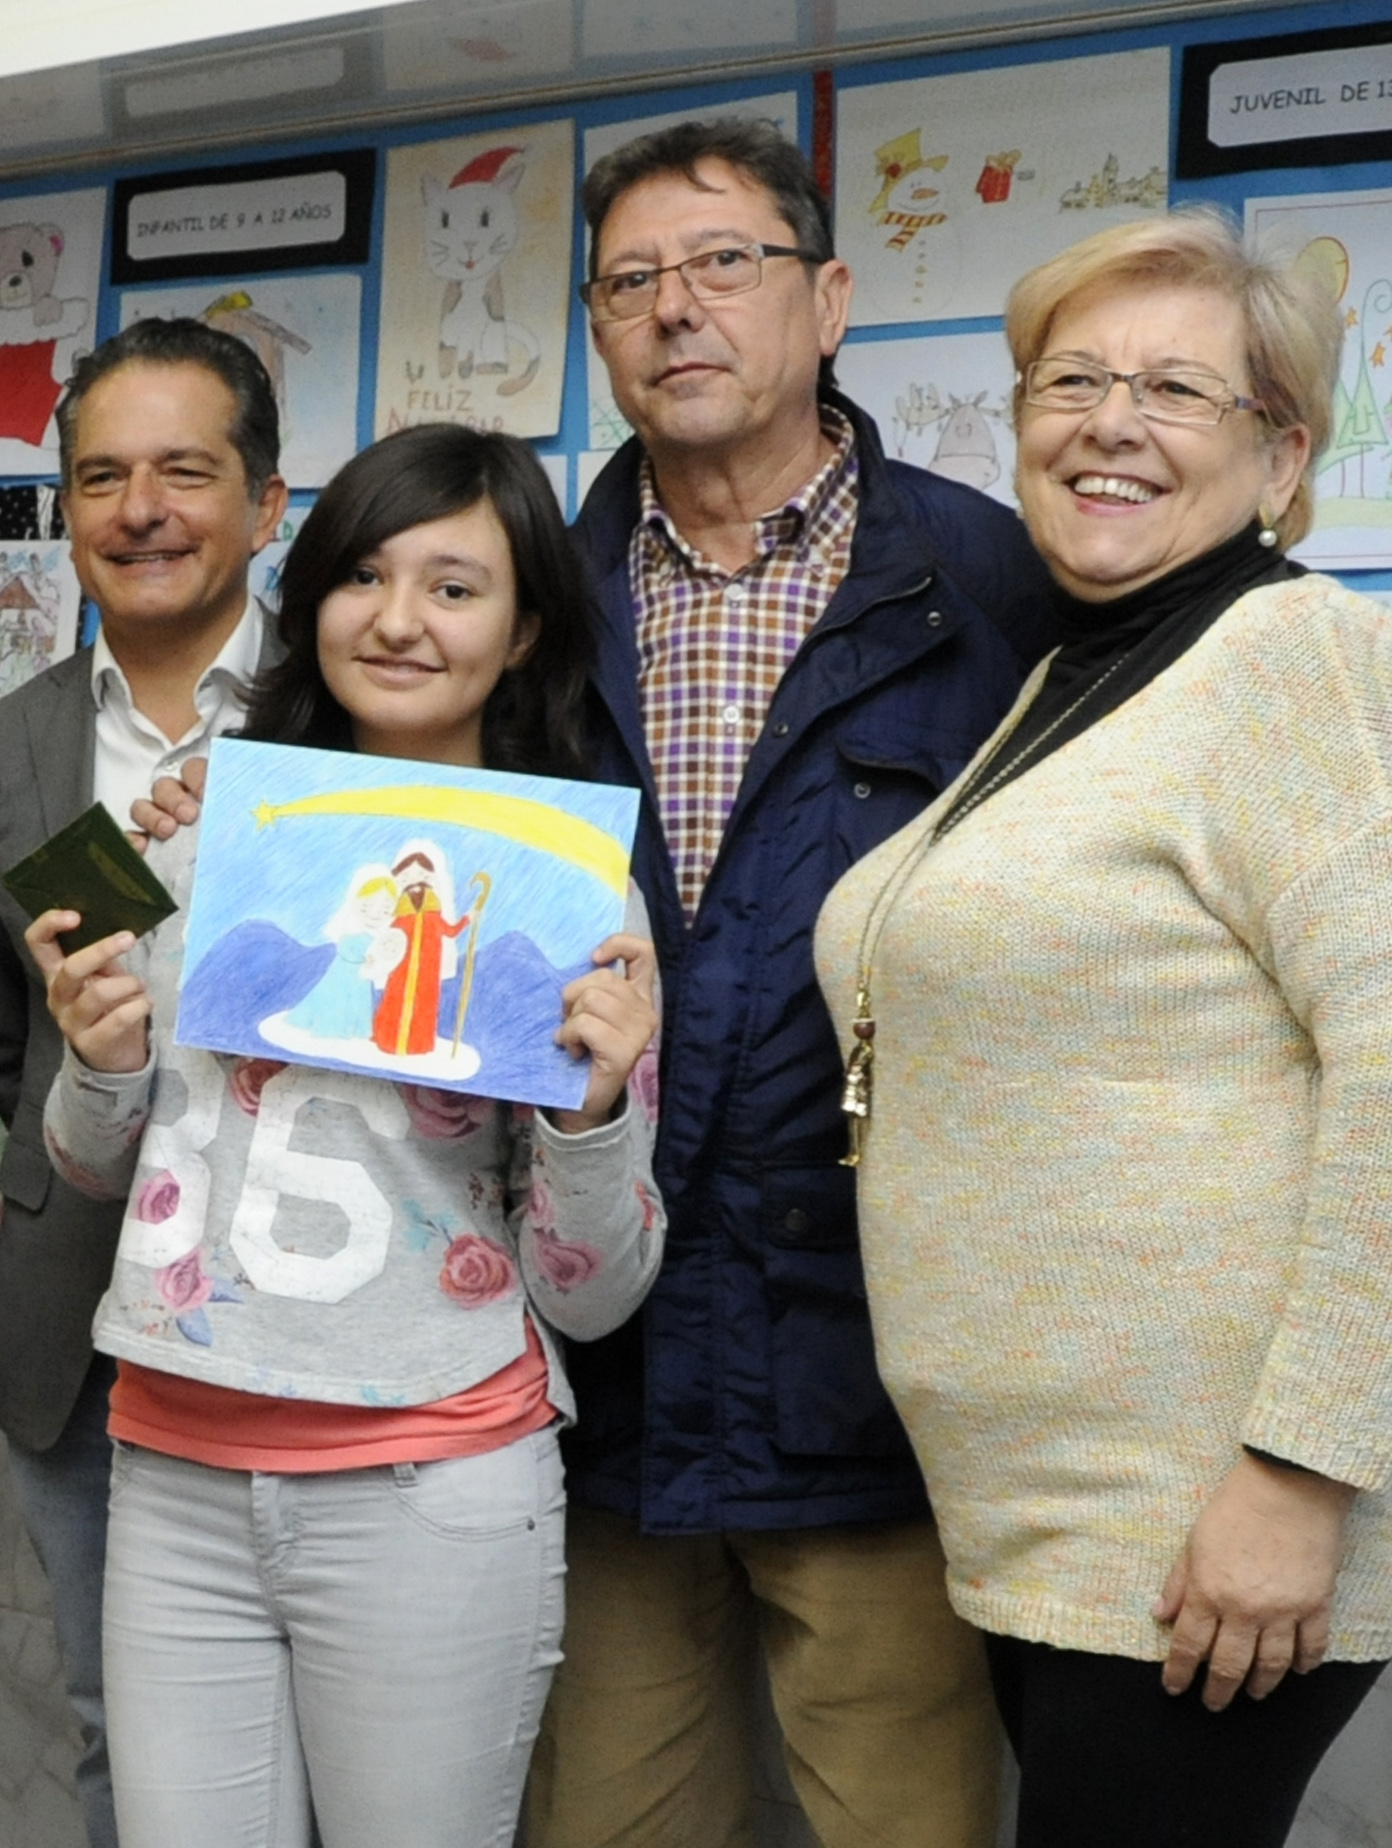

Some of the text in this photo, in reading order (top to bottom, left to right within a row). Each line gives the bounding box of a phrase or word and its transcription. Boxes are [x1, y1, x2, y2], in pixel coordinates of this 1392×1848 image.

[1230, 87, 1326, 114] JUVENIL
[1341, 81, 1370, 102] DE
[137, 201, 332, 238] INFANTIL DE 9 A 12 AÑOS
